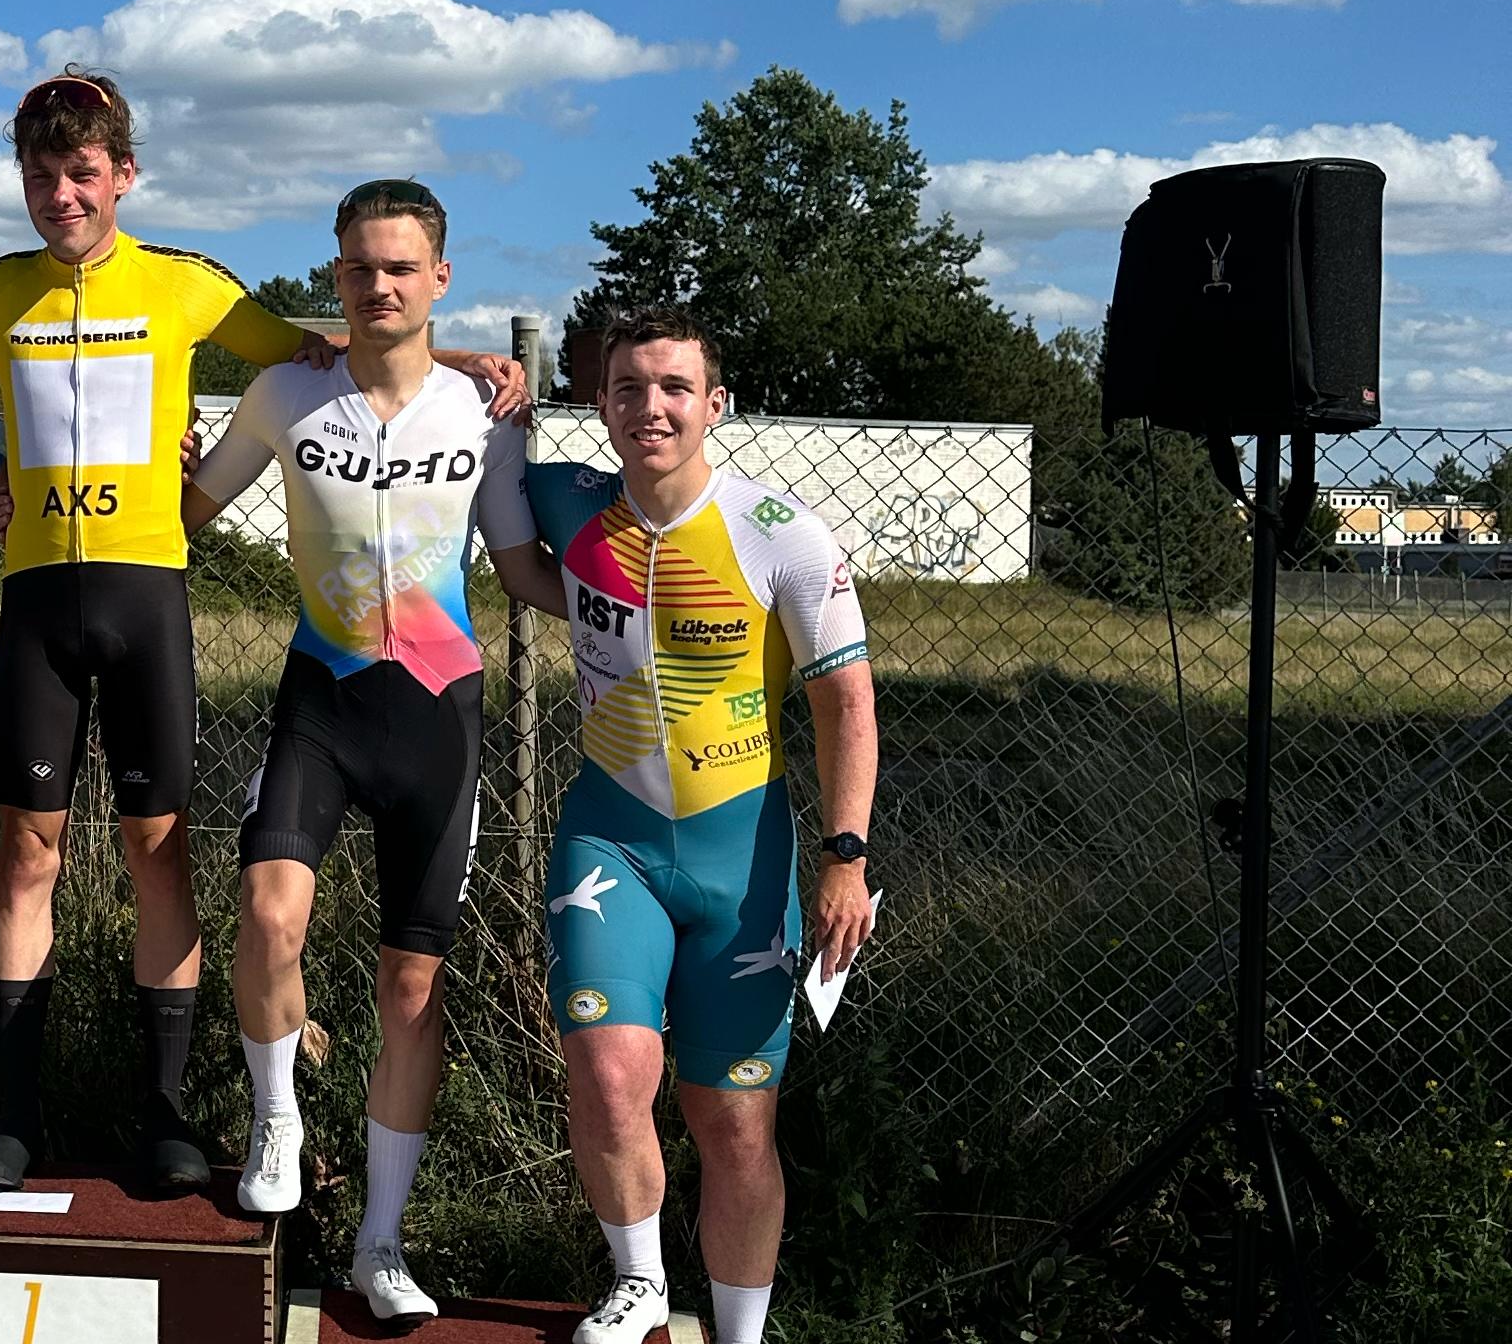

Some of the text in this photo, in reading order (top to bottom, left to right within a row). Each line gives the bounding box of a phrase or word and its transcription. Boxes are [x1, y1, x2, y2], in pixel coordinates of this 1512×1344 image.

[10, 329, 149, 346] RACING SERIES
[323, 421, 359, 444] GOBIK
[41, 484, 118, 518] AX5
[577, 584, 635, 639] RST
[669, 619, 750, 635] Lübeck
[670, 634, 747, 646] Racing Team
